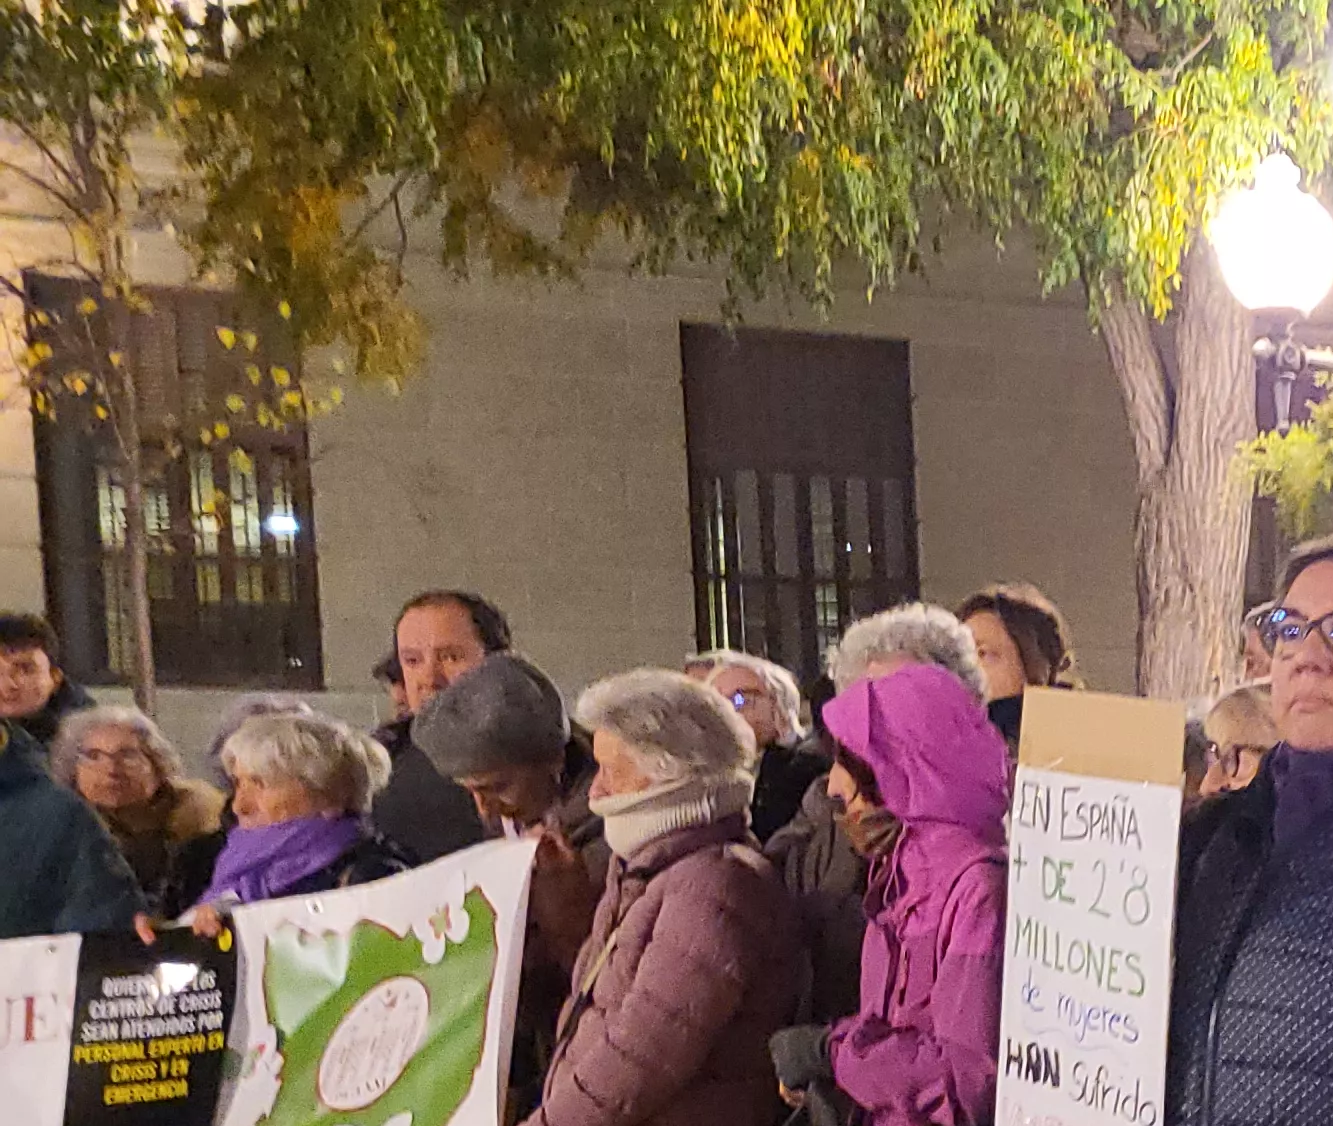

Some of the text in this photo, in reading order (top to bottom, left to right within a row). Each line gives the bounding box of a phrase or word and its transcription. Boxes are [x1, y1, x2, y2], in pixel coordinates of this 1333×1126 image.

[1019, 781, 1051, 833] EN
[1013, 843, 1028, 883] +
[1042, 855, 1076, 905] DE
[1013, 913, 1146, 997] MILLONES
[179, 989, 222, 1013] CRISIS
[1021, 965, 1140, 1044] de mujeres
[73, 1041, 146, 1064] PERSONAL
[207, 1030, 225, 1050] EN
[81, 1020, 119, 1043] SEAN
[1005, 1037, 1061, 1088] HAN
[104, 1077, 189, 1106] EMERGENCIA
